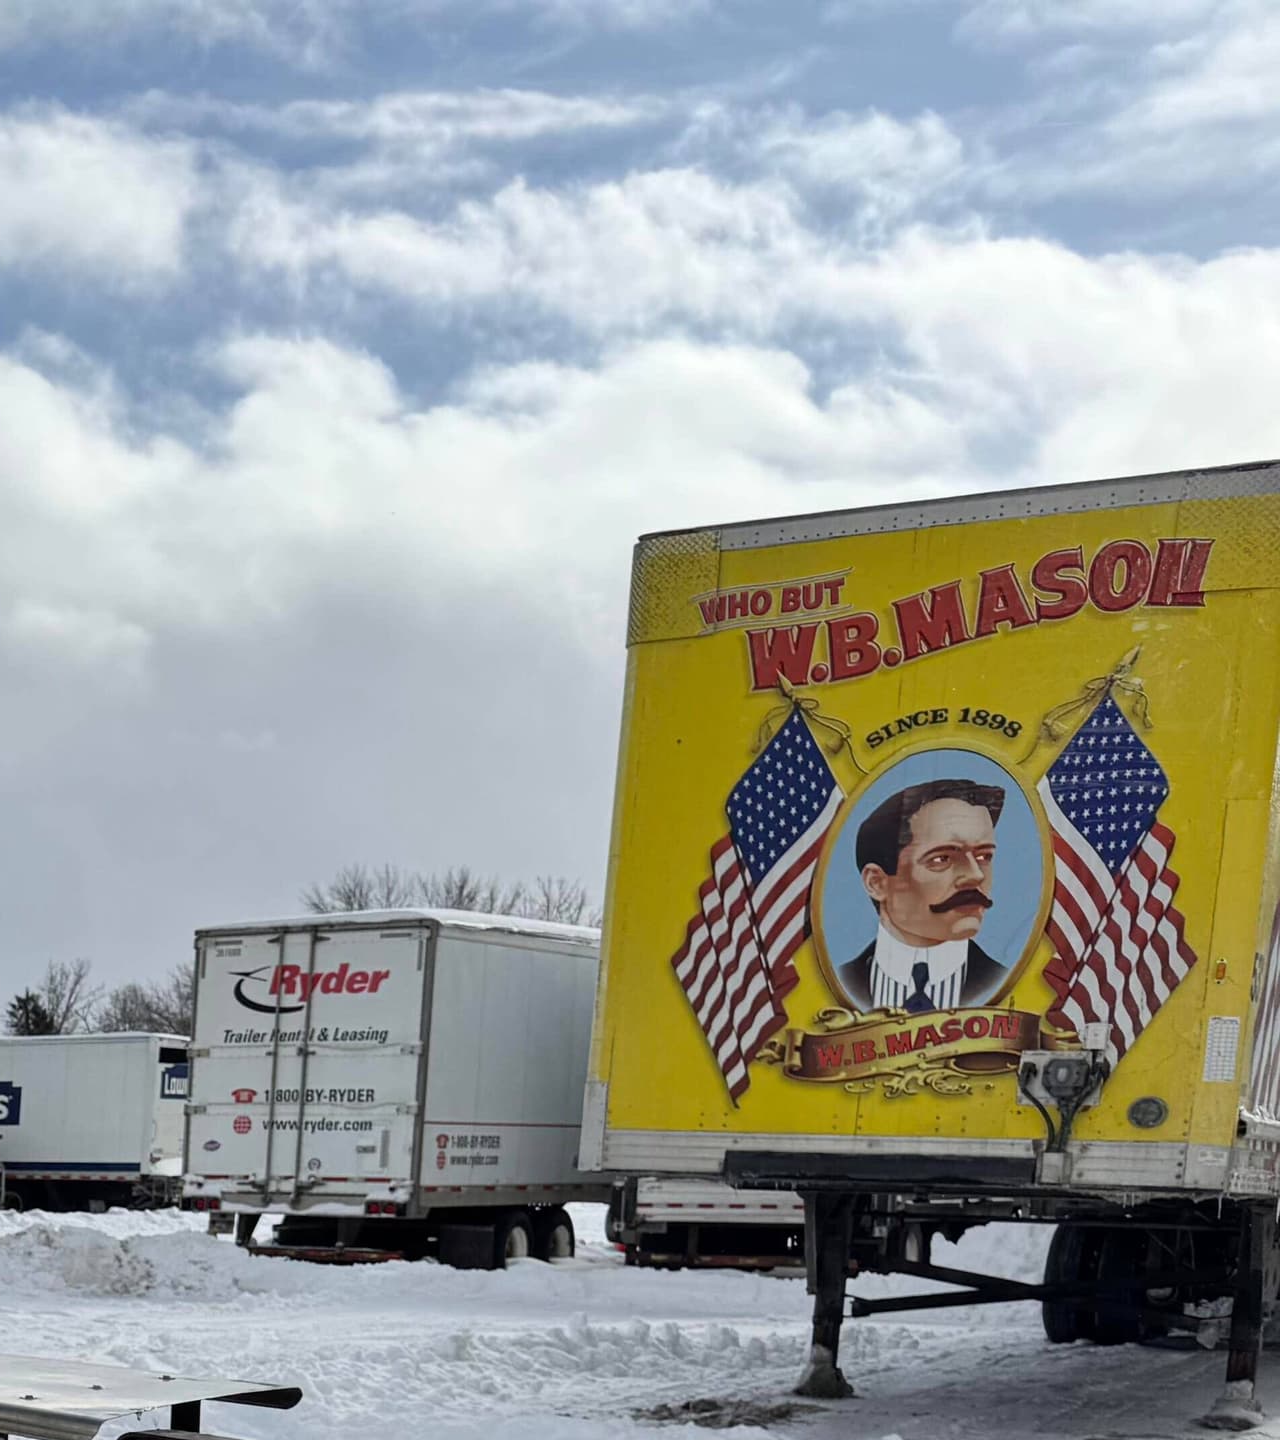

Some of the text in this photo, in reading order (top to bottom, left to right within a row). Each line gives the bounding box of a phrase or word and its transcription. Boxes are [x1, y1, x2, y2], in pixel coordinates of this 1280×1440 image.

[699, 577, 846, 626] WHO BUT
[866, 707, 1022, 749] SINCE 1898
[269, 962, 390, 1002] Ryder
[224, 1028, 267, 1043] Trailer
[317, 1027, 329, 1041] &
[332, 1026, 388, 1044] Leasing
[264, 1088, 375, 1102] 1800BY-RYDER
[262, 1117, 373, 1134] wwwryder.com
